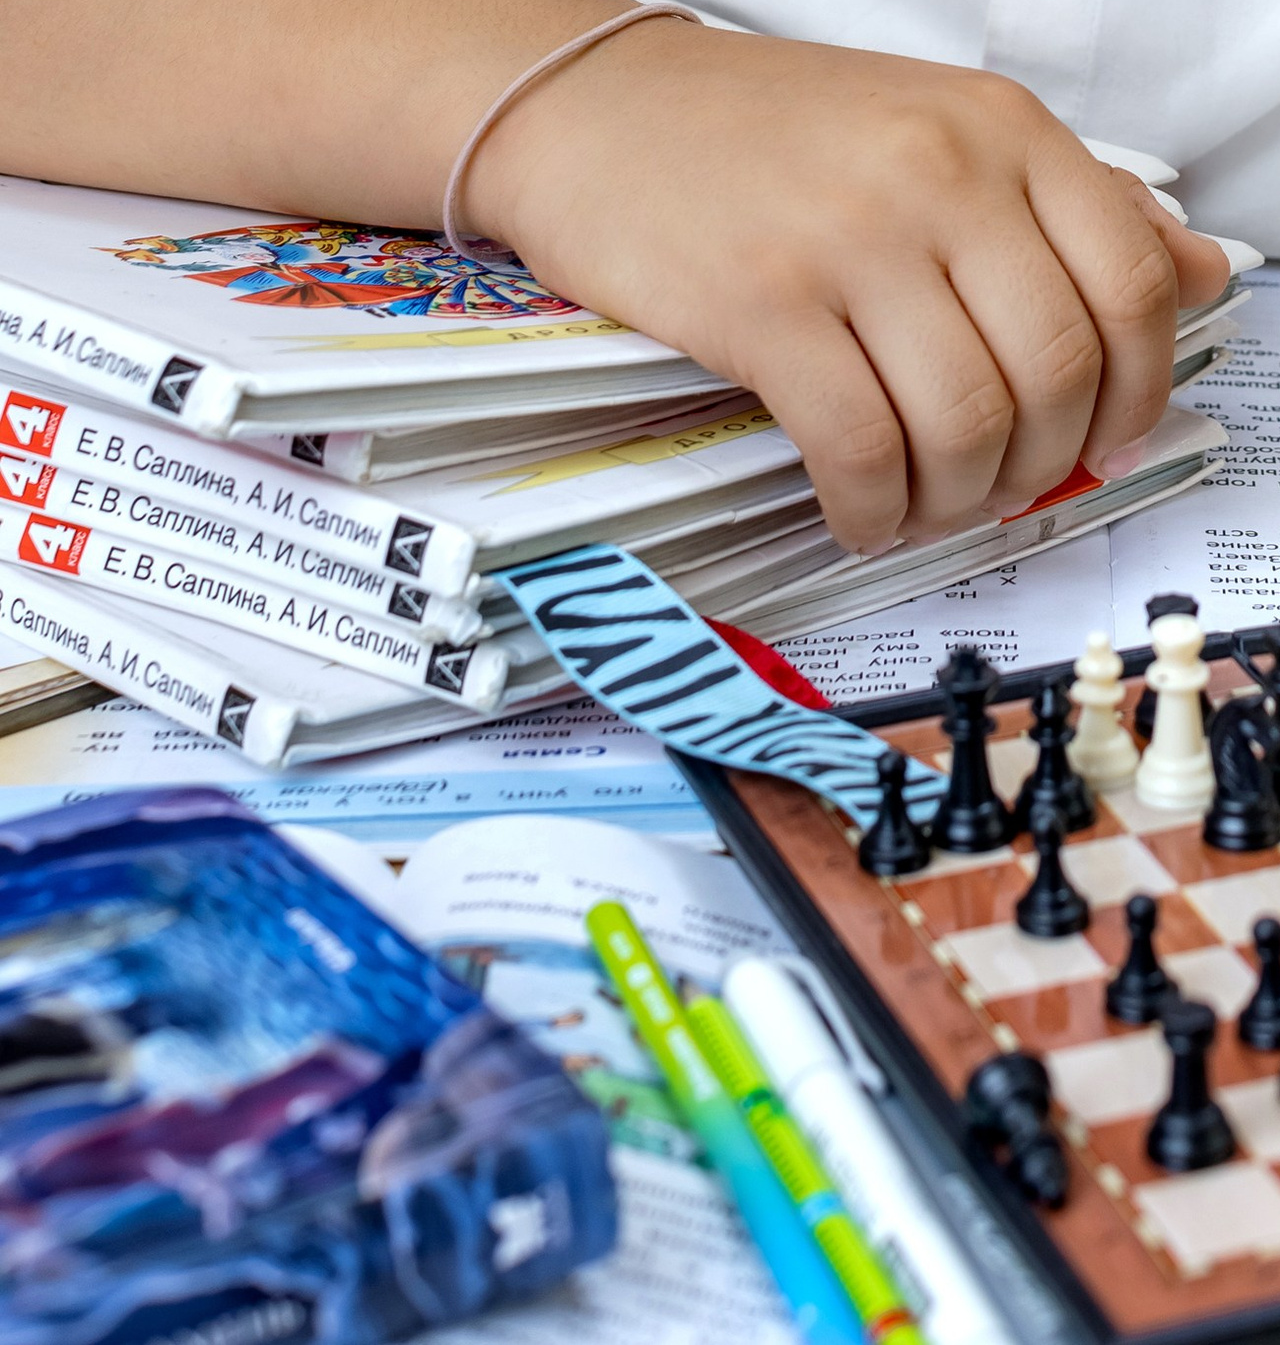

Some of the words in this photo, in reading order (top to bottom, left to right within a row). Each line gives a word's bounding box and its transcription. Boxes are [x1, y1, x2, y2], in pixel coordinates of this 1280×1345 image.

[508, 318, 623, 341] ДРОФ
[27, 319, 48, 348] А.
[52, 326, 77, 358] И.
[76, 336, 154, 387] Саплин
[5, 402, 52, 446] 4
[42, 412, 61, 448] класс
[673, 412, 775, 449] ДРОФ
[76, 427, 99, 457] Е.
[104, 435, 126, 466] В.
[133, 444, 239, 504] Саплина,
[246, 481, 268, 510] А.
[273, 487, 295, 520] И.
[300, 497, 382, 550] Саплин
[1201, 478, 1256, 488] горе
[28, 521, 77, 564] 4
[71, 478, 94, 508] Е.
[99, 486, 122, 516] В.
[129, 495, 239, 554] Саплина,
[246, 532, 268, 559] А.
[274, 539, 296, 569] И.
[301, 548, 386, 597] Саплин
[1205, 529, 1258, 537] есть
[67, 531, 87, 567] класс
[1208, 563, 1248, 571] эта
[103, 545, 126, 575] Е.
[133, 554, 156, 584] В.
[164, 562, 271, 621] Саплина,
[279, 597, 301, 627] А.
[307, 604, 330, 638] И.
[335, 615, 421, 668] Саплин
[943, 590, 978, 600] На
[771, 630, 914, 647] рассматри
[871, 643, 920, 653] ему
[939, 629, 1018, 639] твою»
[10, 597, 93, 664] Саплина,
[97, 640, 116, 671] А.
[120, 648, 141, 682] И.
[143, 661, 216, 718] Саплин
[868, 656, 932, 668] сыну
[503, 745, 607, 758] Семья
